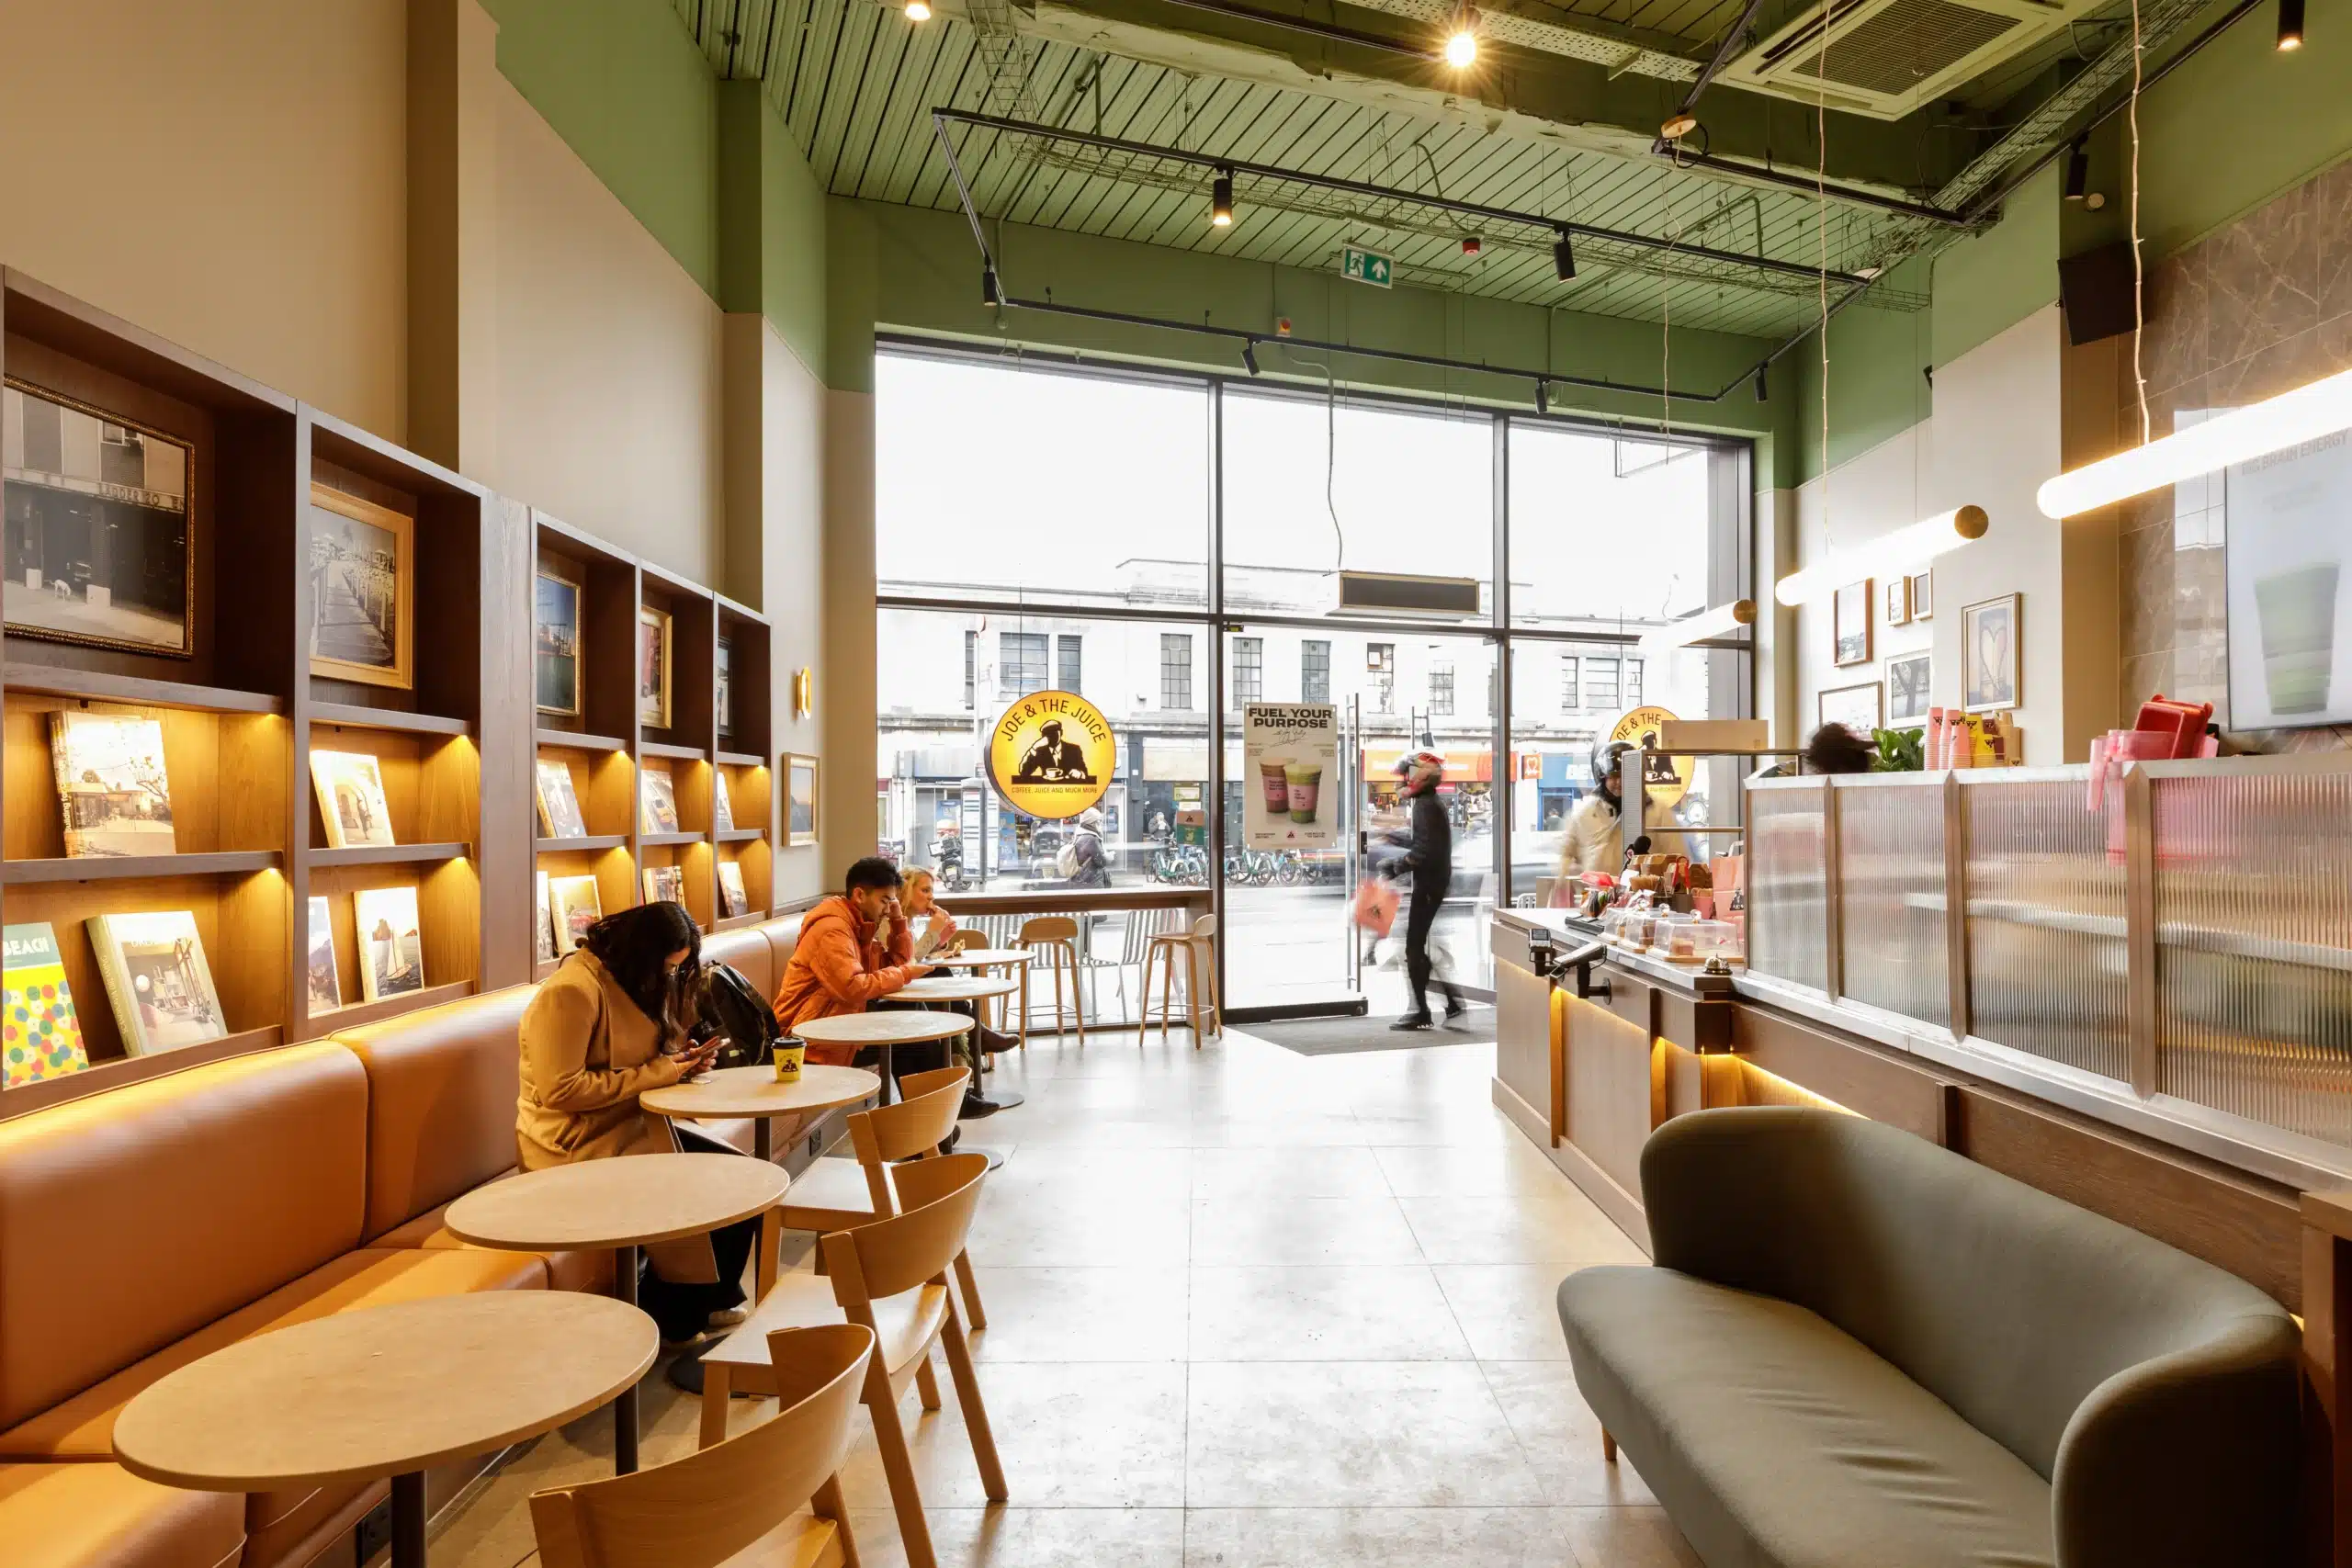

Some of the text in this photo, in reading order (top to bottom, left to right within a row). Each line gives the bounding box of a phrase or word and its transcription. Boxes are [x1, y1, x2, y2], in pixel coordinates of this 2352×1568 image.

[1001, 699, 1107, 743] JOE & THE JUICE
[1249, 707, 1332, 719] FUEL YOUR
[1253, 717, 1329, 728] PURPOSE
[1616, 713, 1662, 741] OE & THE
[3, 936, 51, 957] BEACH
